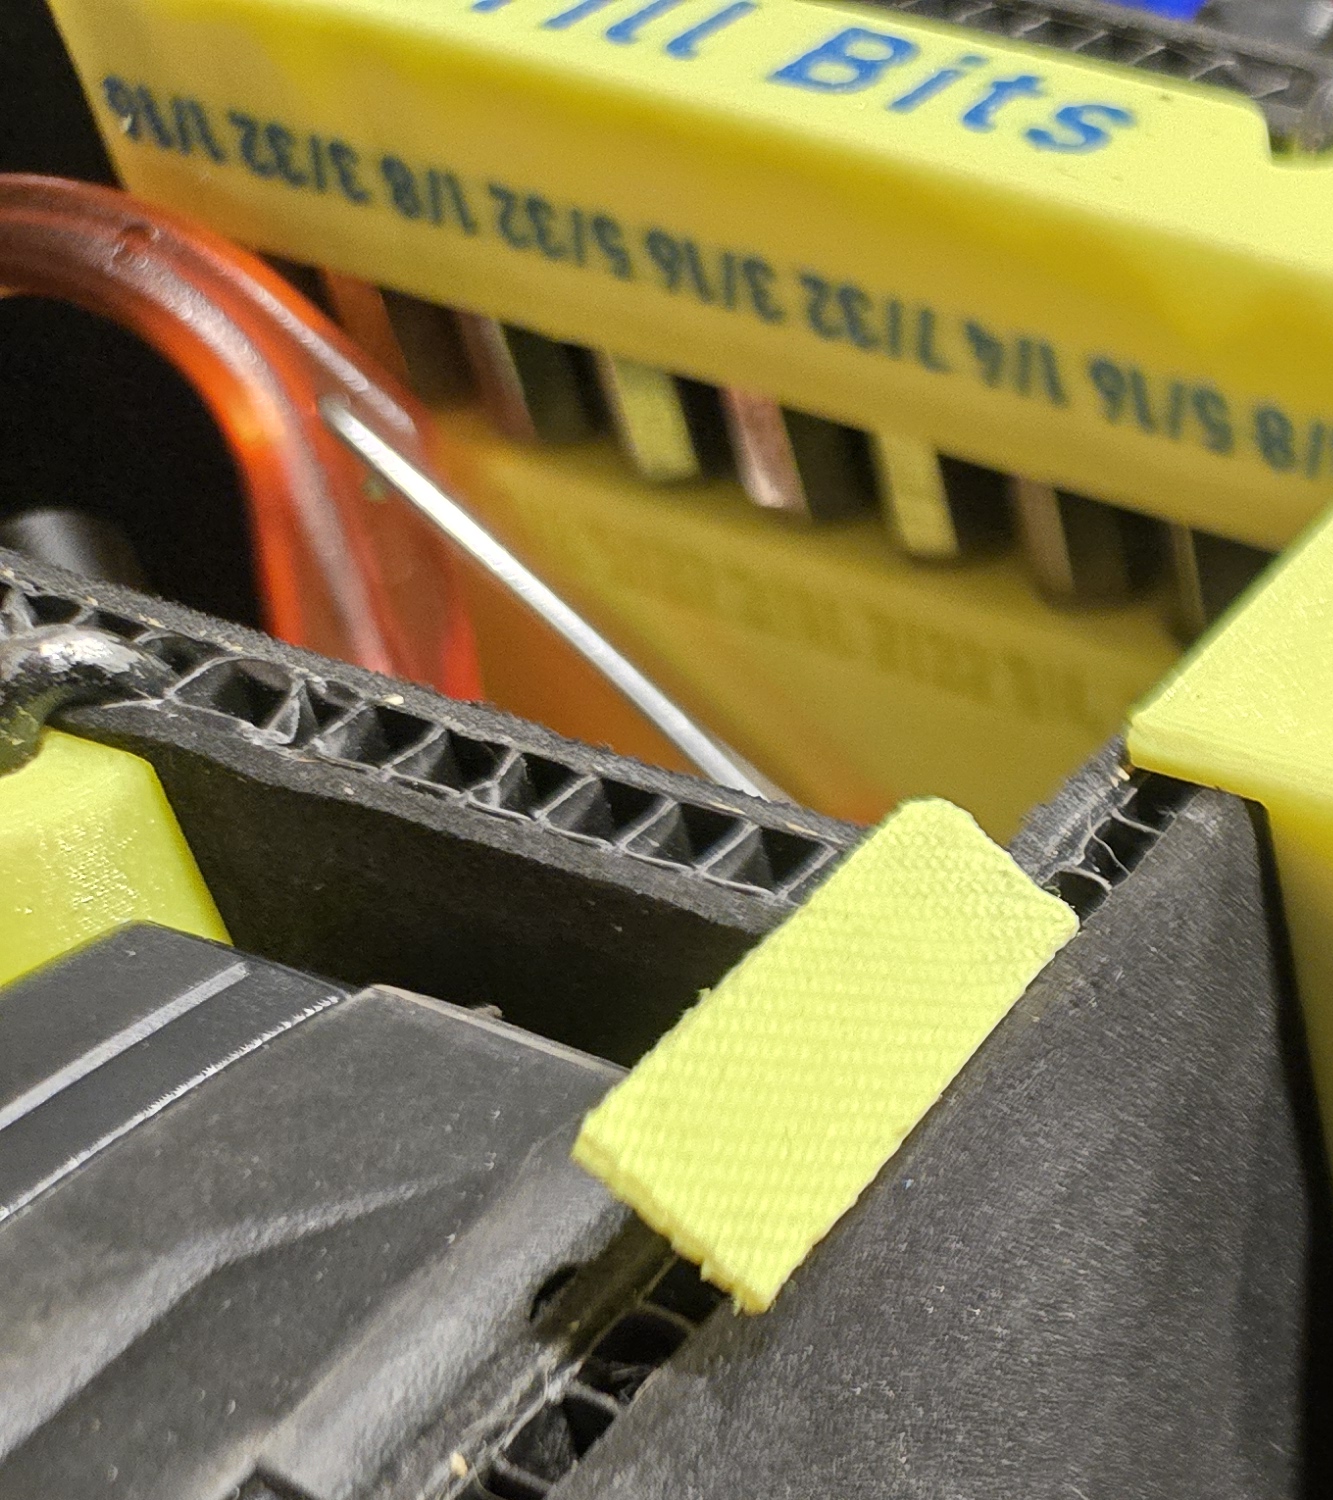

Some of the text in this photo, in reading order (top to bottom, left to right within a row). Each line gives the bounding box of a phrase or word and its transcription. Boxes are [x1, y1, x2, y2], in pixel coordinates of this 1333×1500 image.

[102, 75, 232, 166] 1/16
[767, 26, 1135, 155] Bits
[228, 110, 370, 206] 3/32
[380, 152, 482, 236] 1/8
[486, 179, 633, 281] 5/32
[643, 228, 787, 324] 3/16
[797, 263, 952, 374] 7/32
[963, 320, 1071, 410] 1/4
[1087, 353, 1235, 456] 5/16
